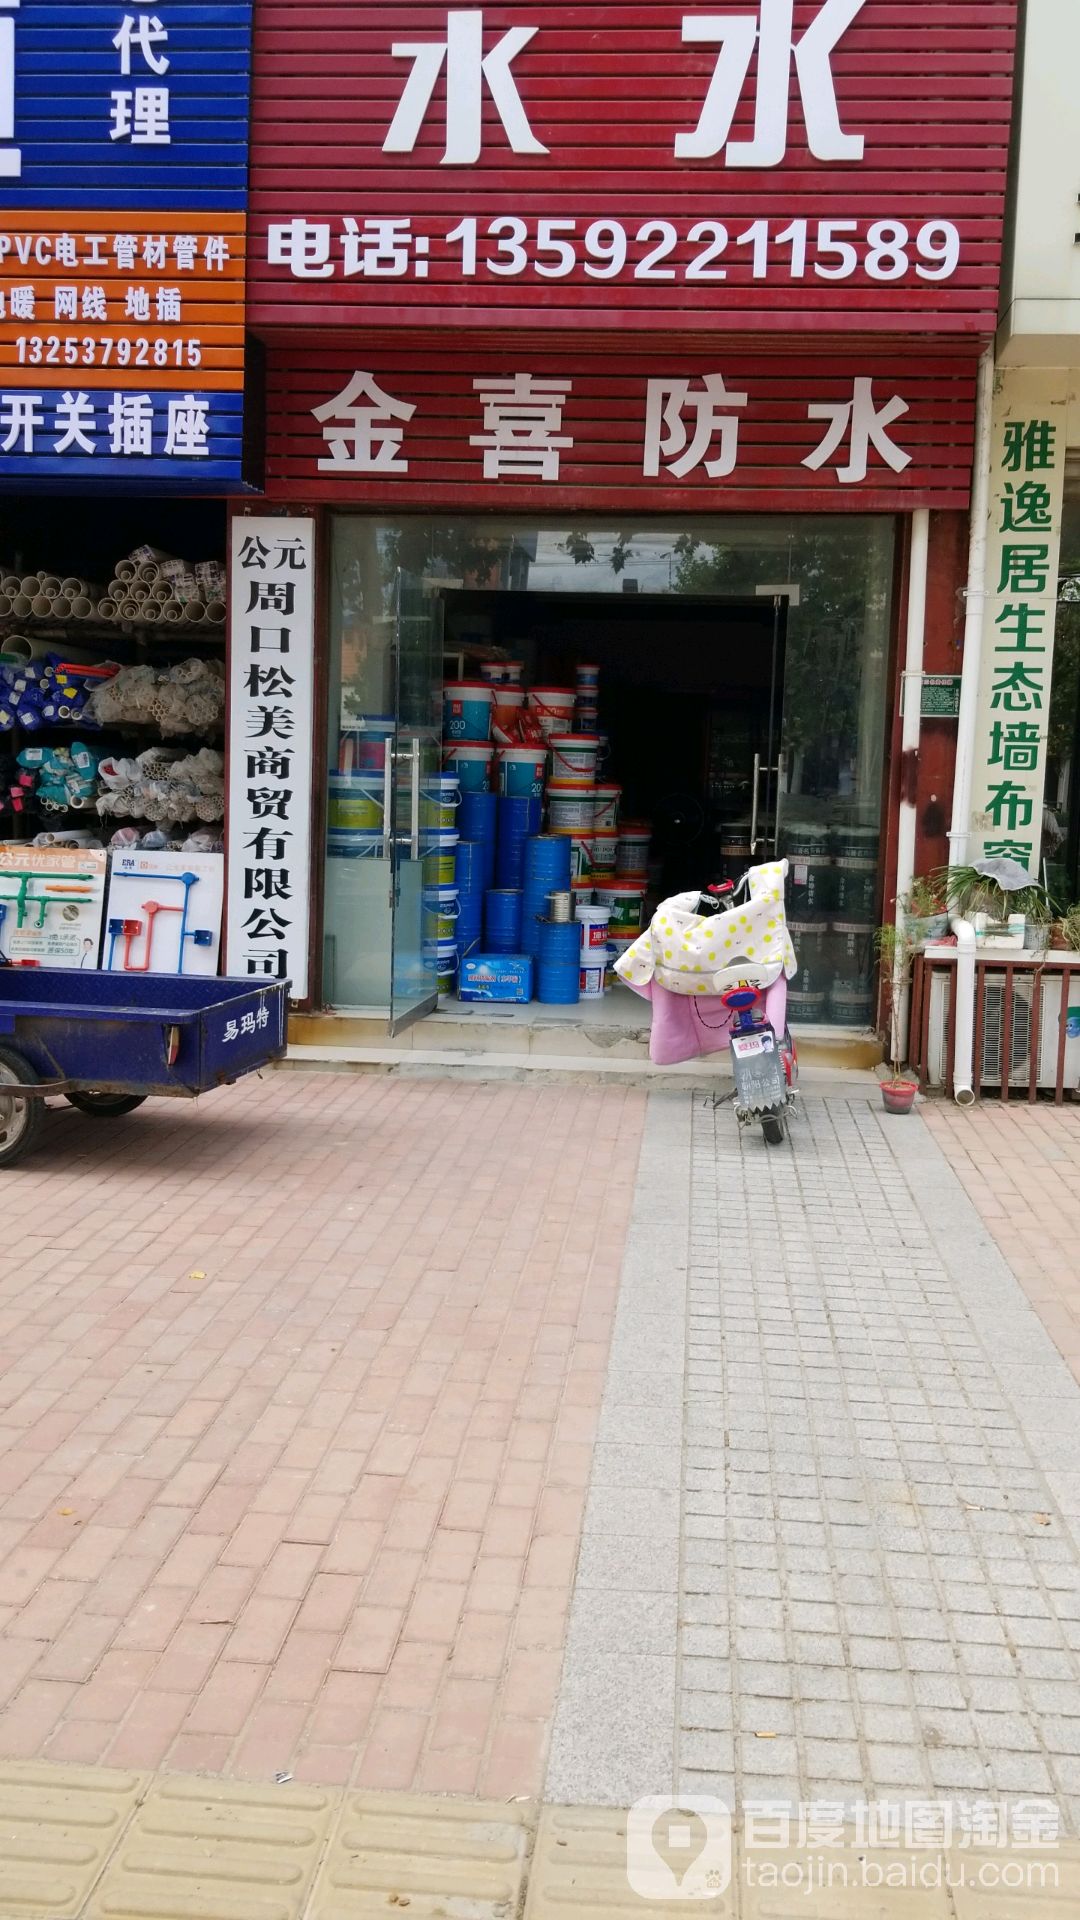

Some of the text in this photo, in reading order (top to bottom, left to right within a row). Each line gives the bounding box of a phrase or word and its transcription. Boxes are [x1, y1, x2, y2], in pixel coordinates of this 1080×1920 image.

[109, 14, 171, 144] 代理
[382, 10, 550, 164] 水
[674, 0, 865, 167] 水
[0, 286, 182, 322] 暖 网线 地插
[16, 335, 201, 366] 13253792815
[0, 391, 210, 455] 开关插座
[311, 370, 913, 483] 金喜防水
[238, 535, 307, 570] 公元
[241, 580, 297, 979] 周口松美商贸有限公司
[222, 1006, 270, 1042] 易玛特
